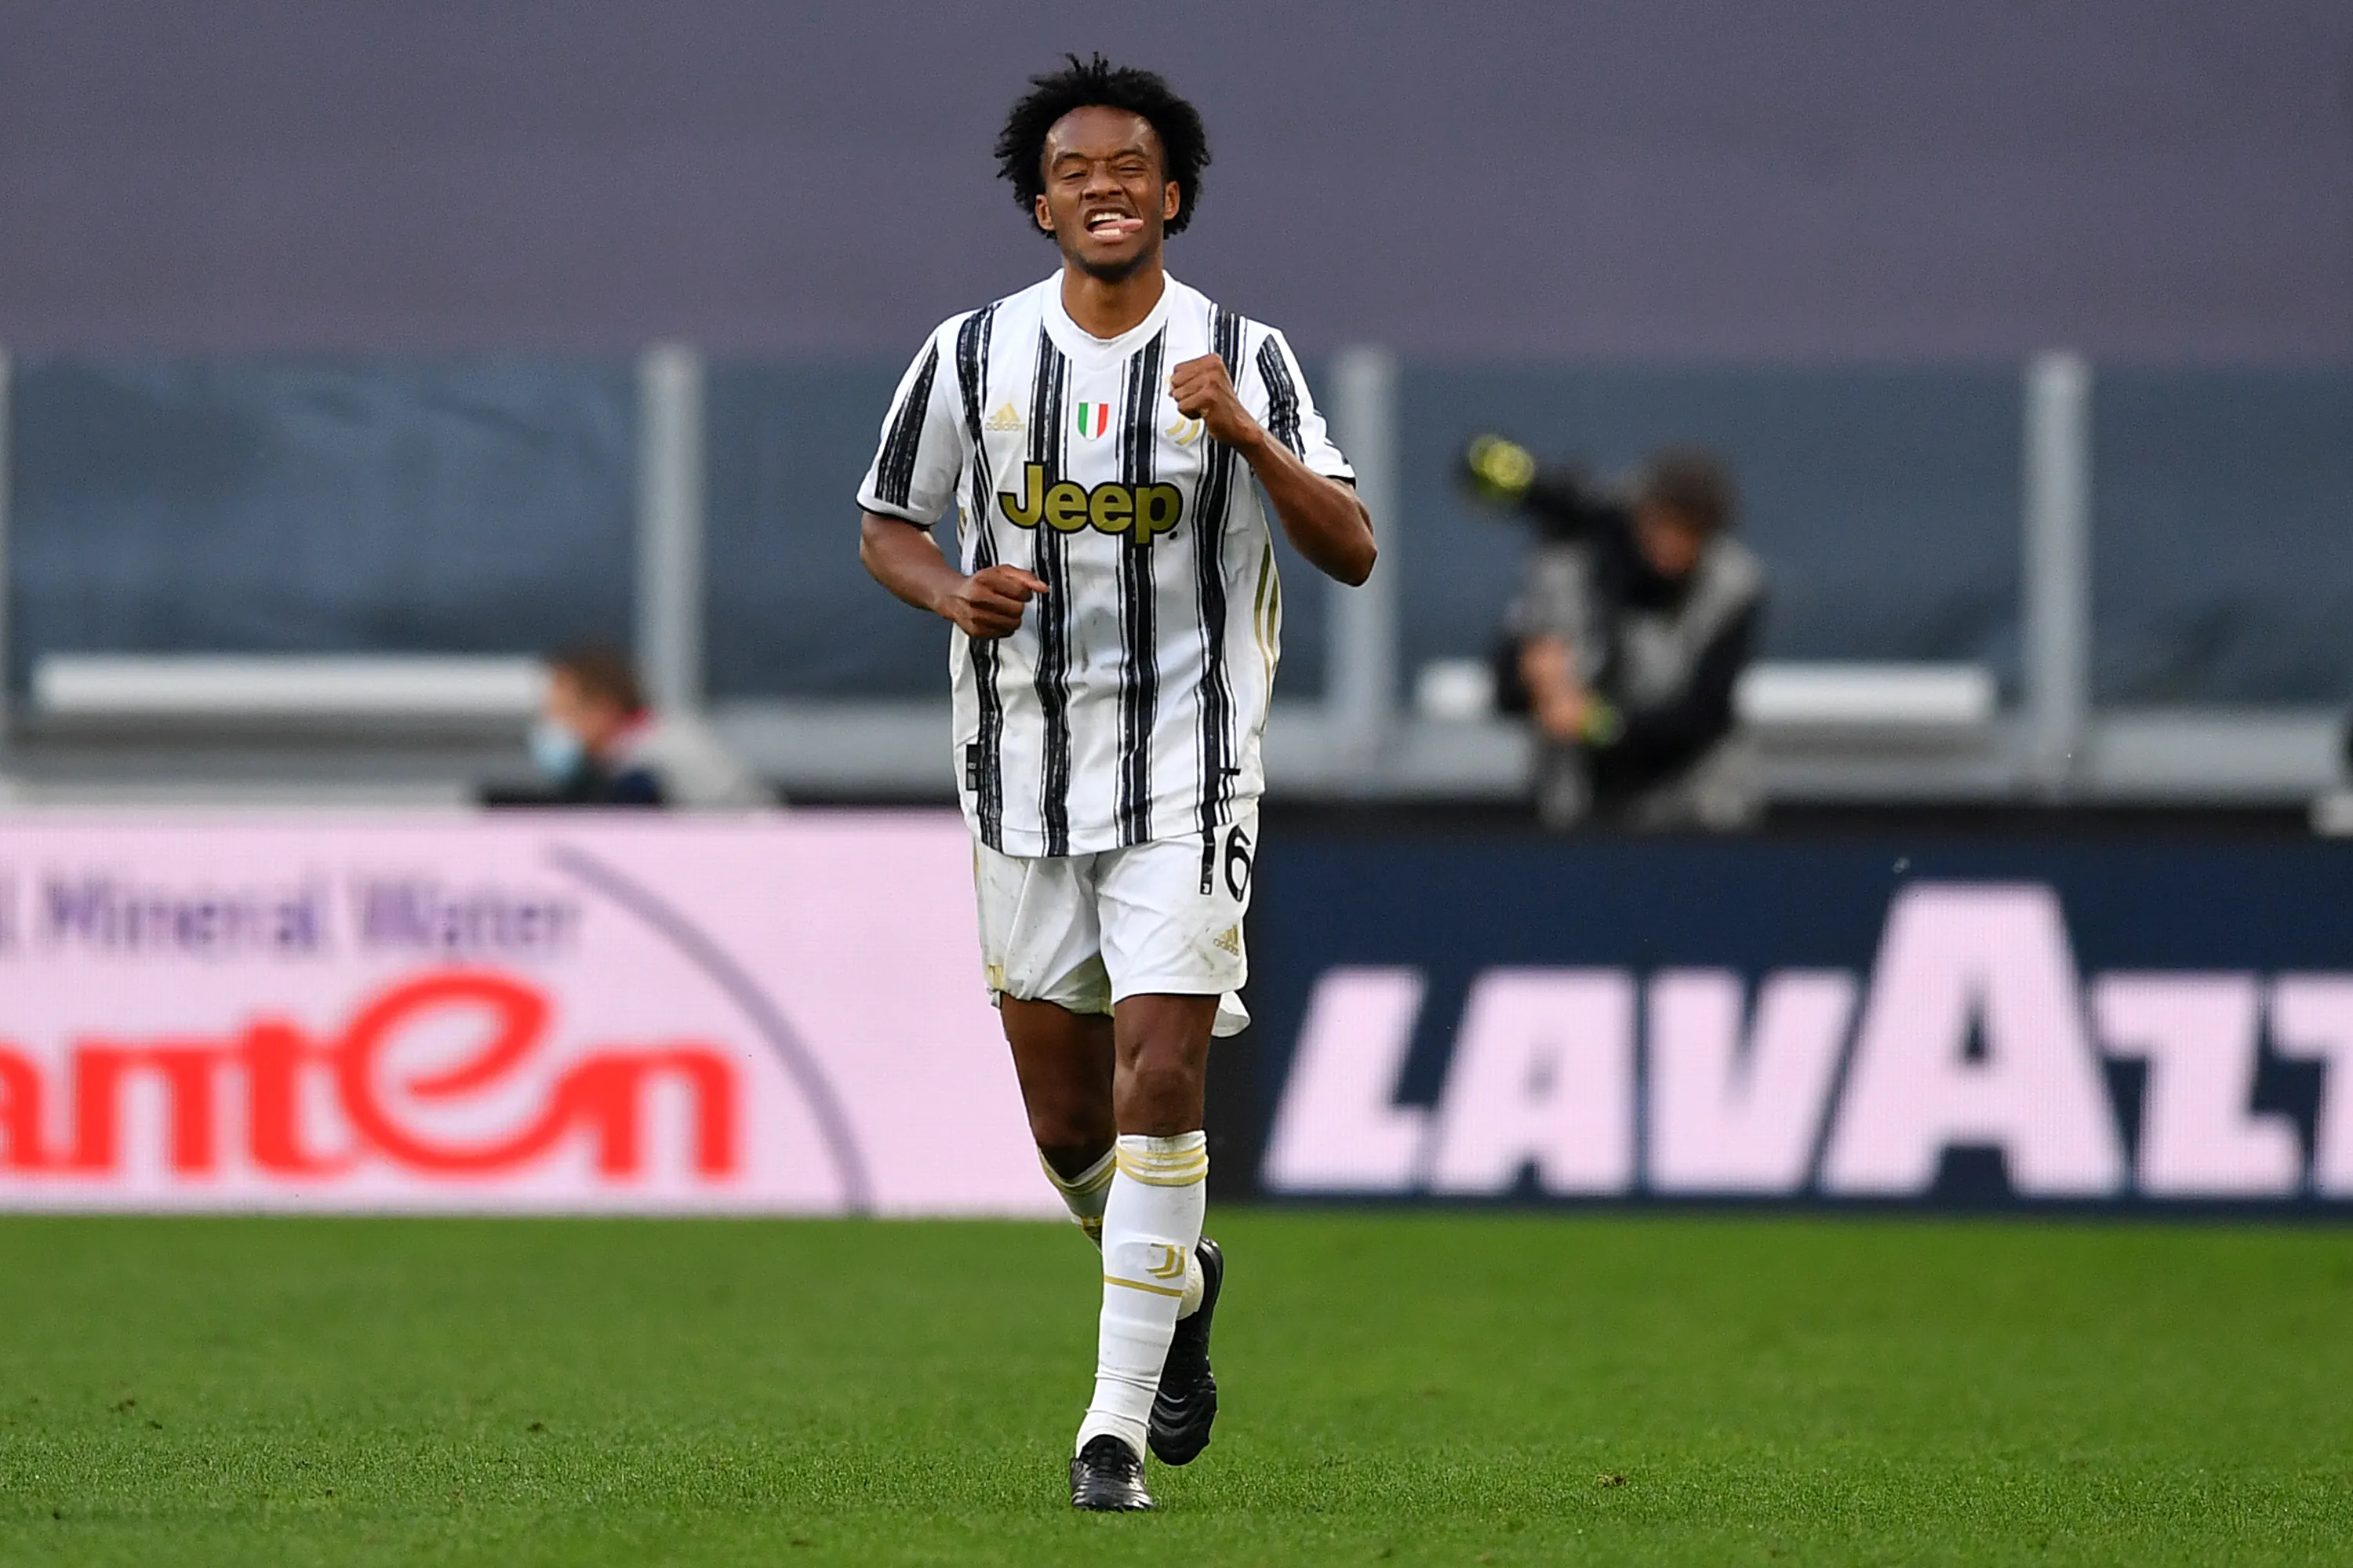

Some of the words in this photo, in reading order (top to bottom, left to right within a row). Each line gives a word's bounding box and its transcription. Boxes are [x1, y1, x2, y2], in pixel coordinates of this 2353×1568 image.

[998, 461, 1183, 547] Jeep
[1200, 824, 1251, 903] 16
[43, 872, 323, 949] Mineral
[362, 875, 578, 948] Water
